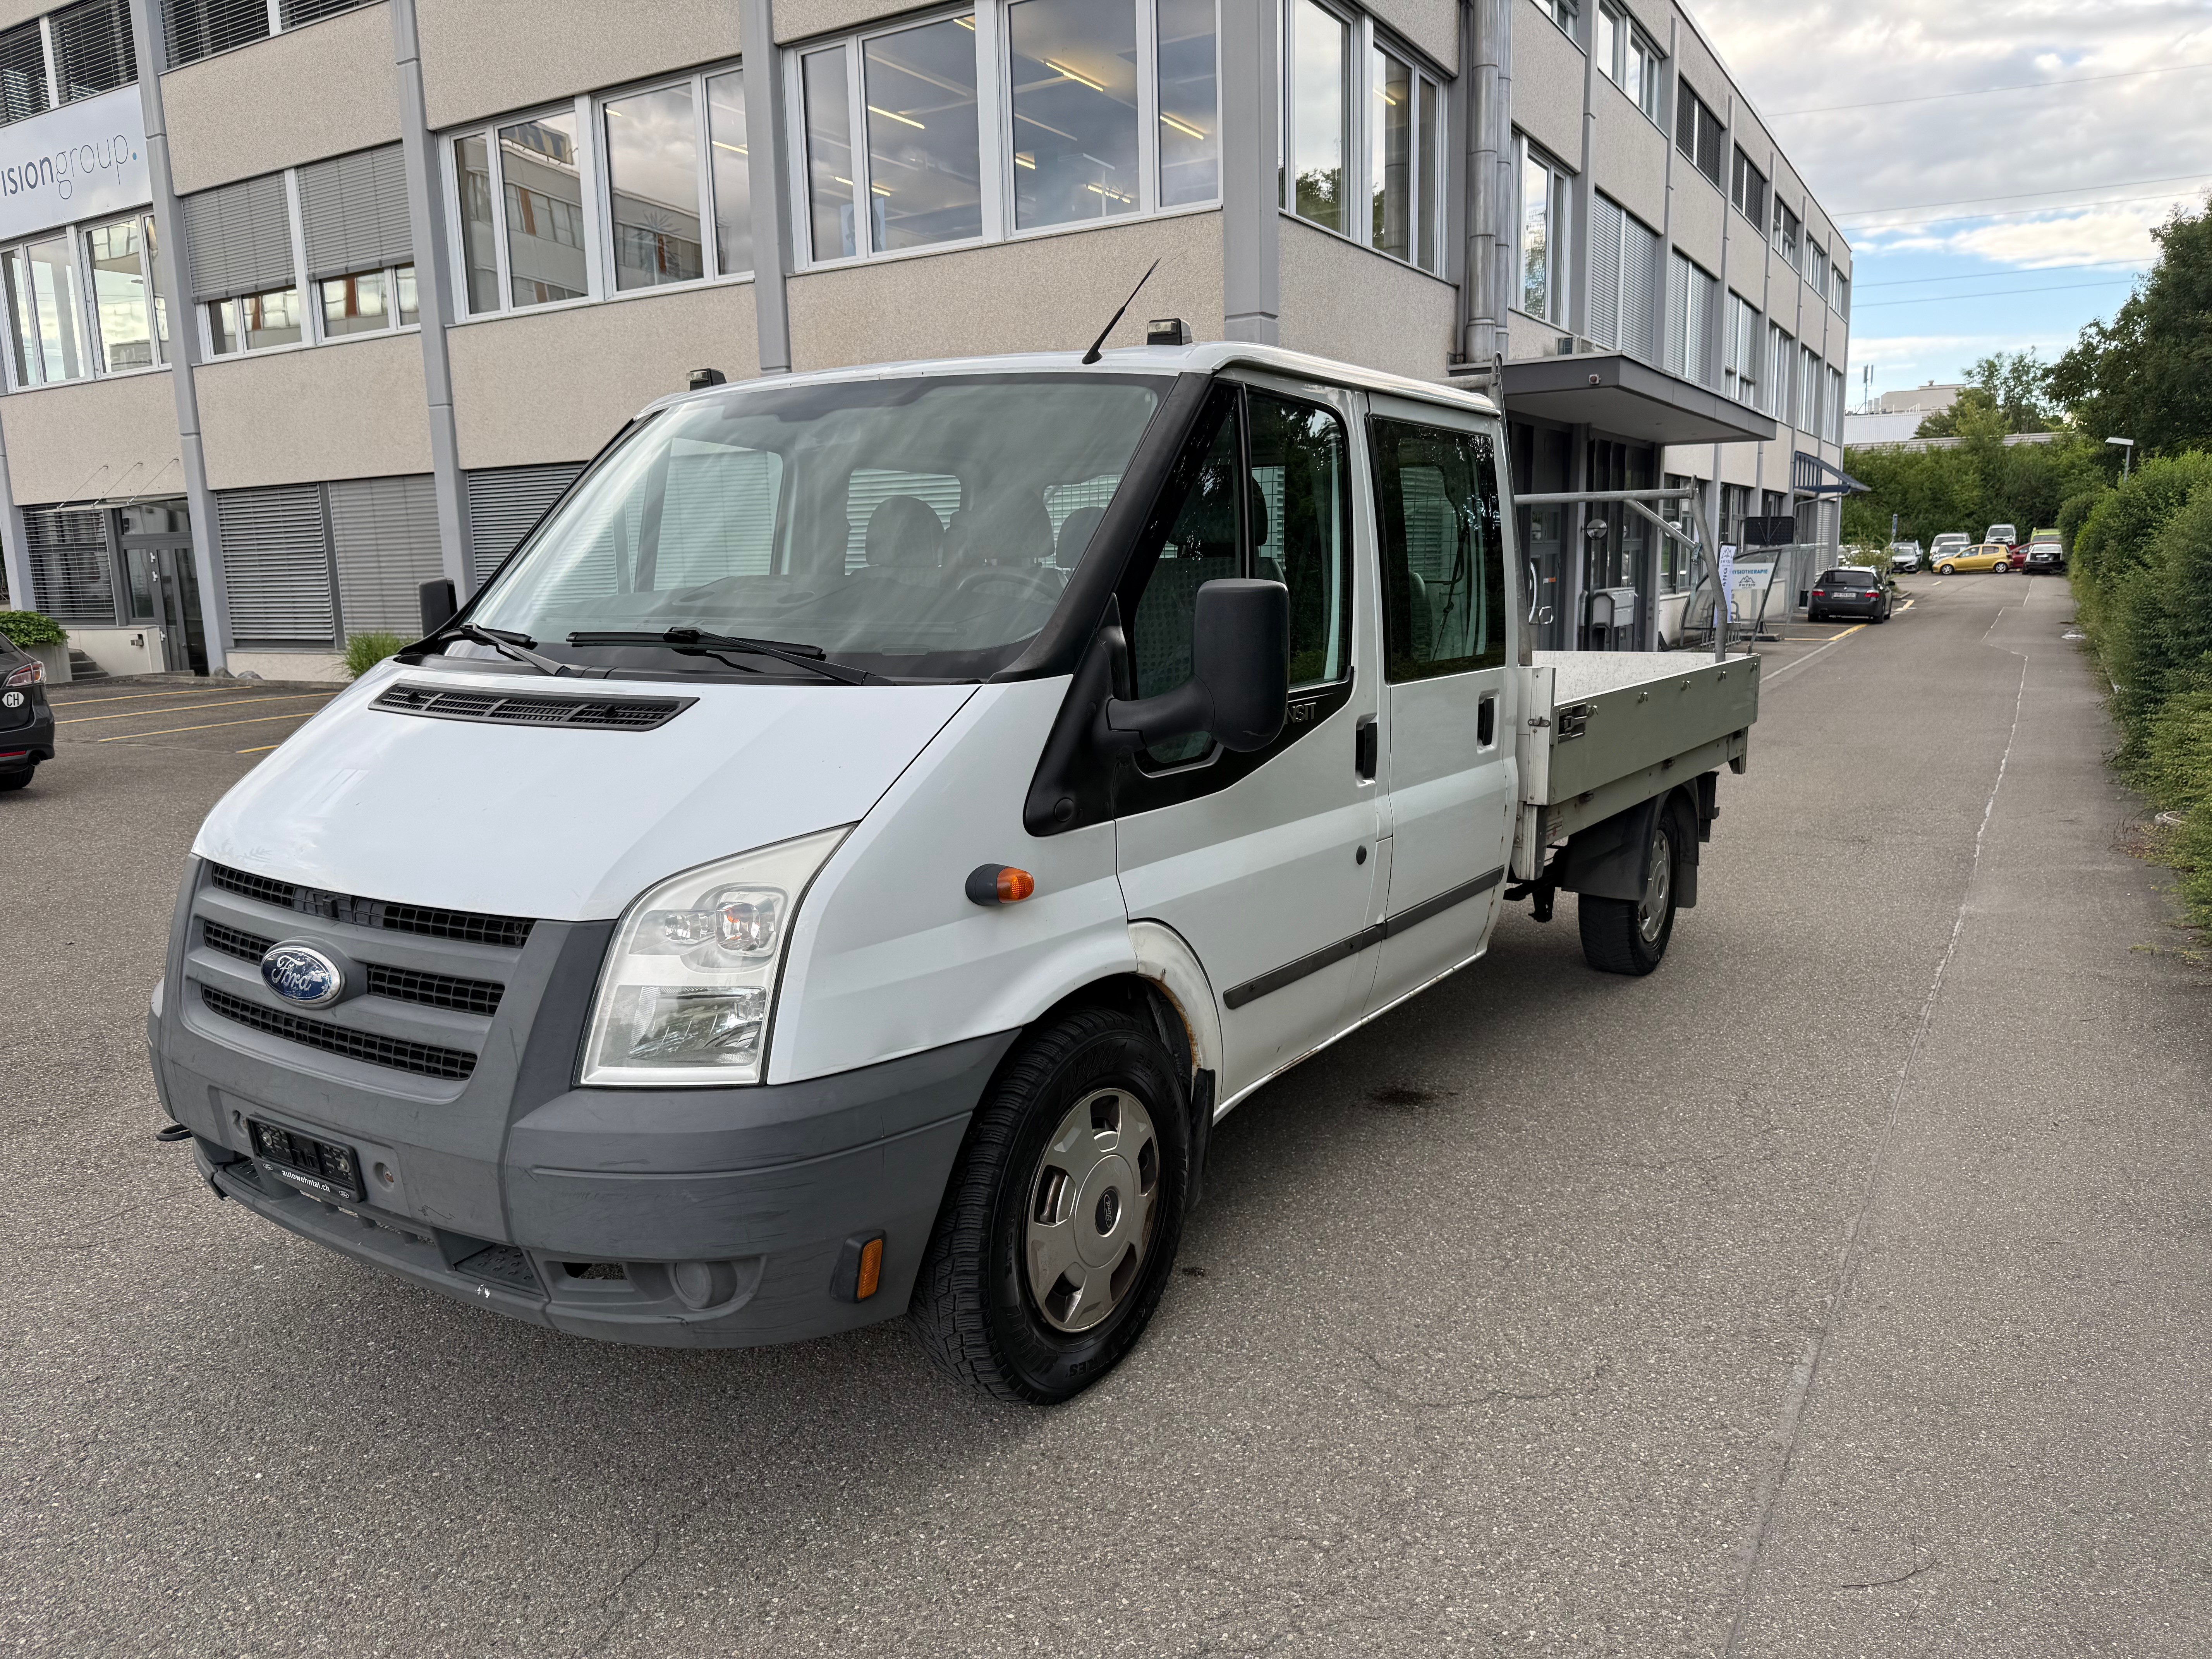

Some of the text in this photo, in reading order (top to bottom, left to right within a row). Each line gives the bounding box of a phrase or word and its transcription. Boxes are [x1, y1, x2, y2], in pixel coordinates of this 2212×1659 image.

[7, 693, 19, 706] CH
[271, 955, 314, 991] Ford
[282, 1170, 330, 1192] autowehntal.ch
